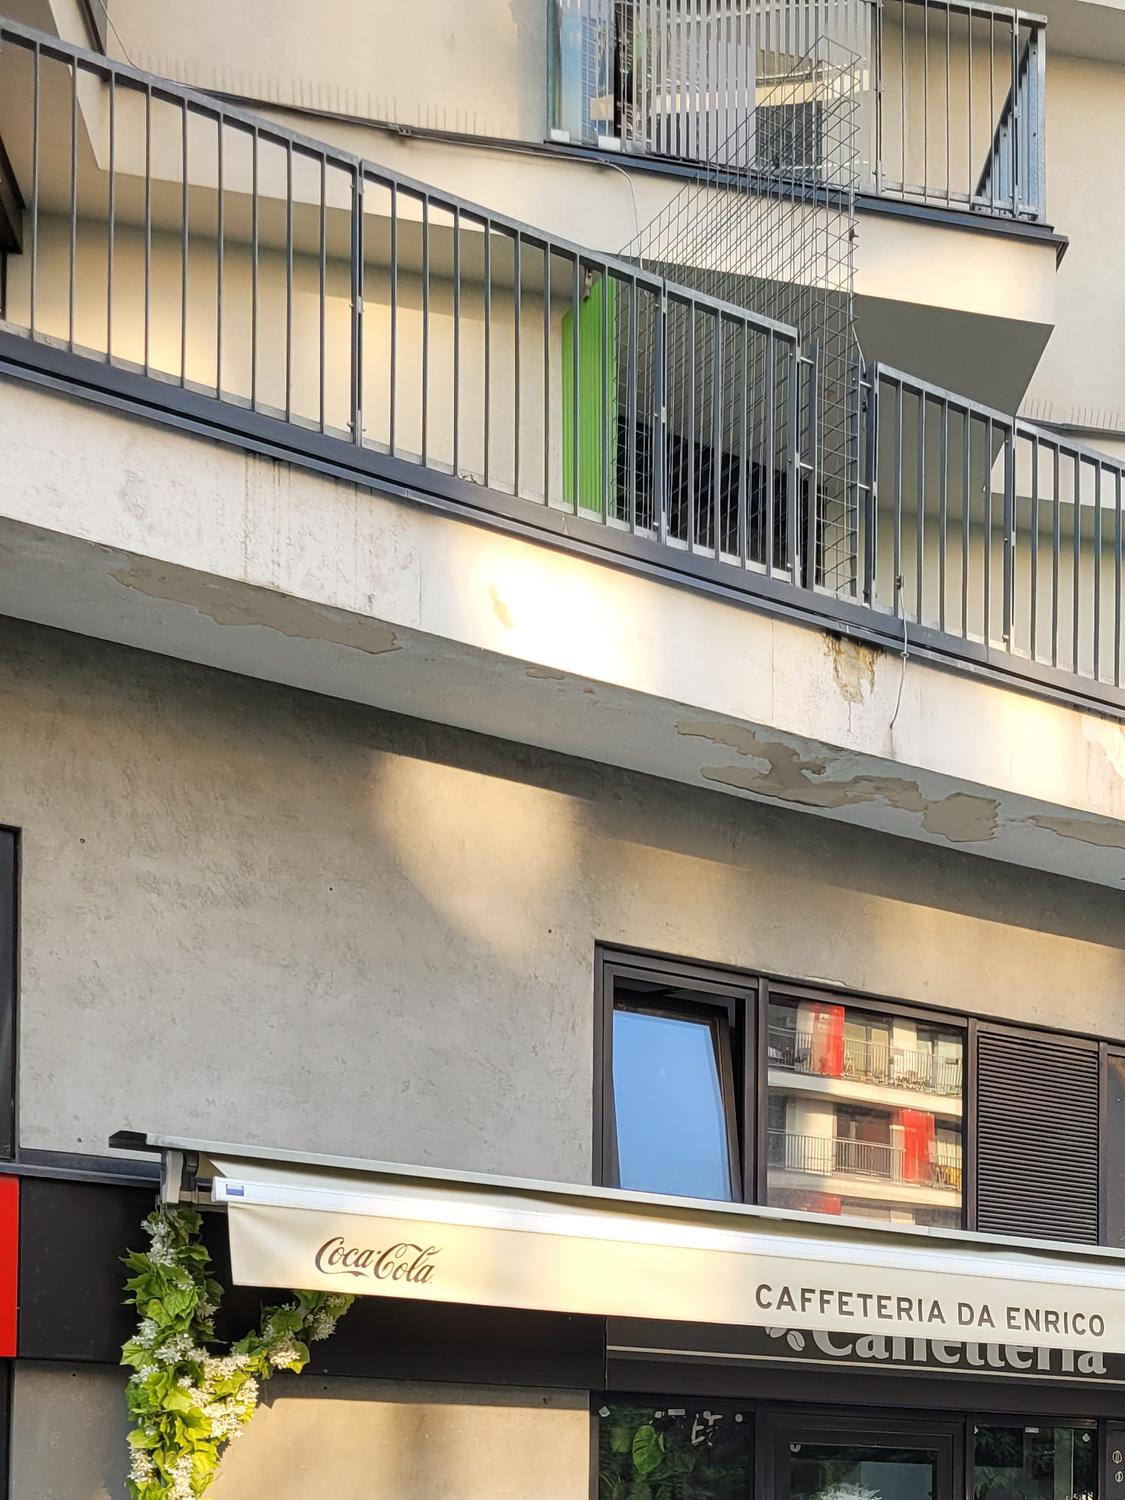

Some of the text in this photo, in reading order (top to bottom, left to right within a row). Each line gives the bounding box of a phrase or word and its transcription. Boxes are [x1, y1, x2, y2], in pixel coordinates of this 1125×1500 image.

[315, 1237, 442, 1284] Coca-Cola
[754, 1284, 1106, 1338] CAFFETERIA DA ENRICO
